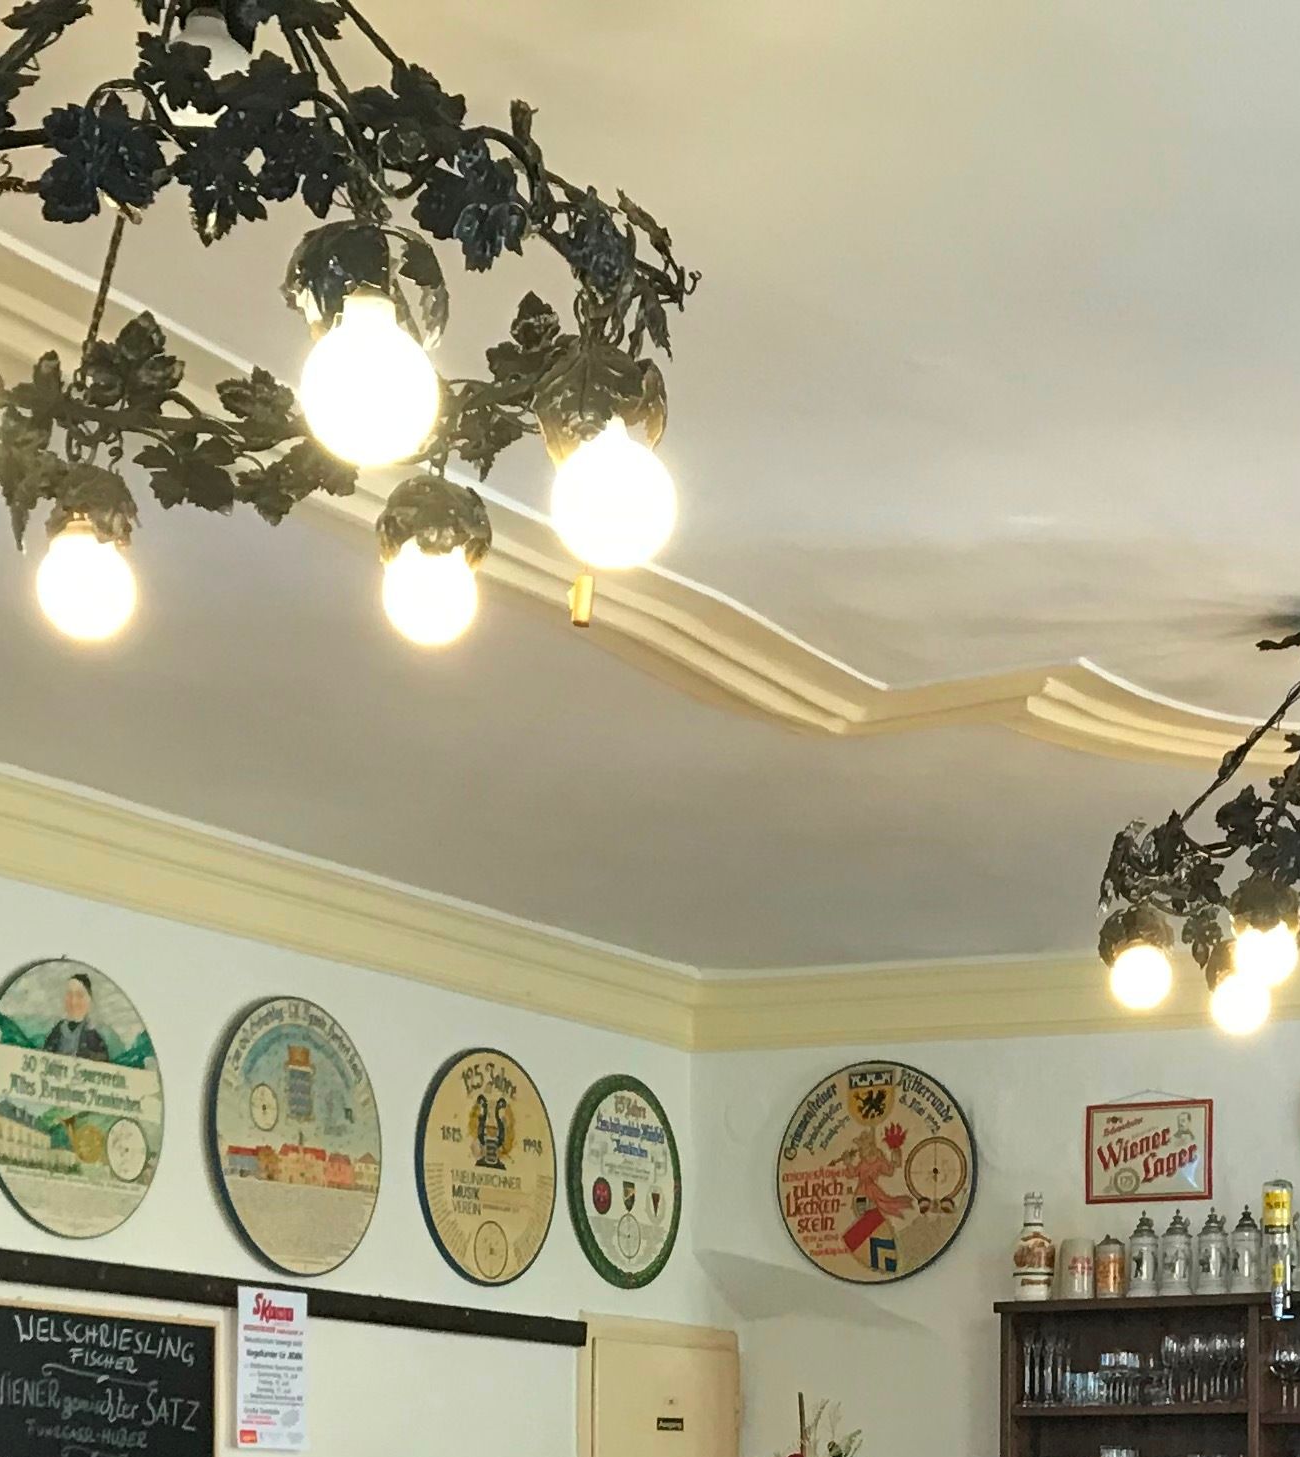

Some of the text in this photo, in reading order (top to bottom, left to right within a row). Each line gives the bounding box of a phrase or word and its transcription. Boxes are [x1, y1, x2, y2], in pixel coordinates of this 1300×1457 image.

[461, 1062, 517, 1098] 125 Jahre
[1096, 1126, 1172, 1173] Wiener
[1141, 1142, 1198, 1184] Lager
[451, 1183, 481, 1201] MUSIK
[451, 1198, 483, 1216] VEREIN
[12, 1313, 197, 1368] WELSCHRIESLING
[68, 1346, 139, 1374] FISCHER
[141, 1386, 201, 1433] SATZ
